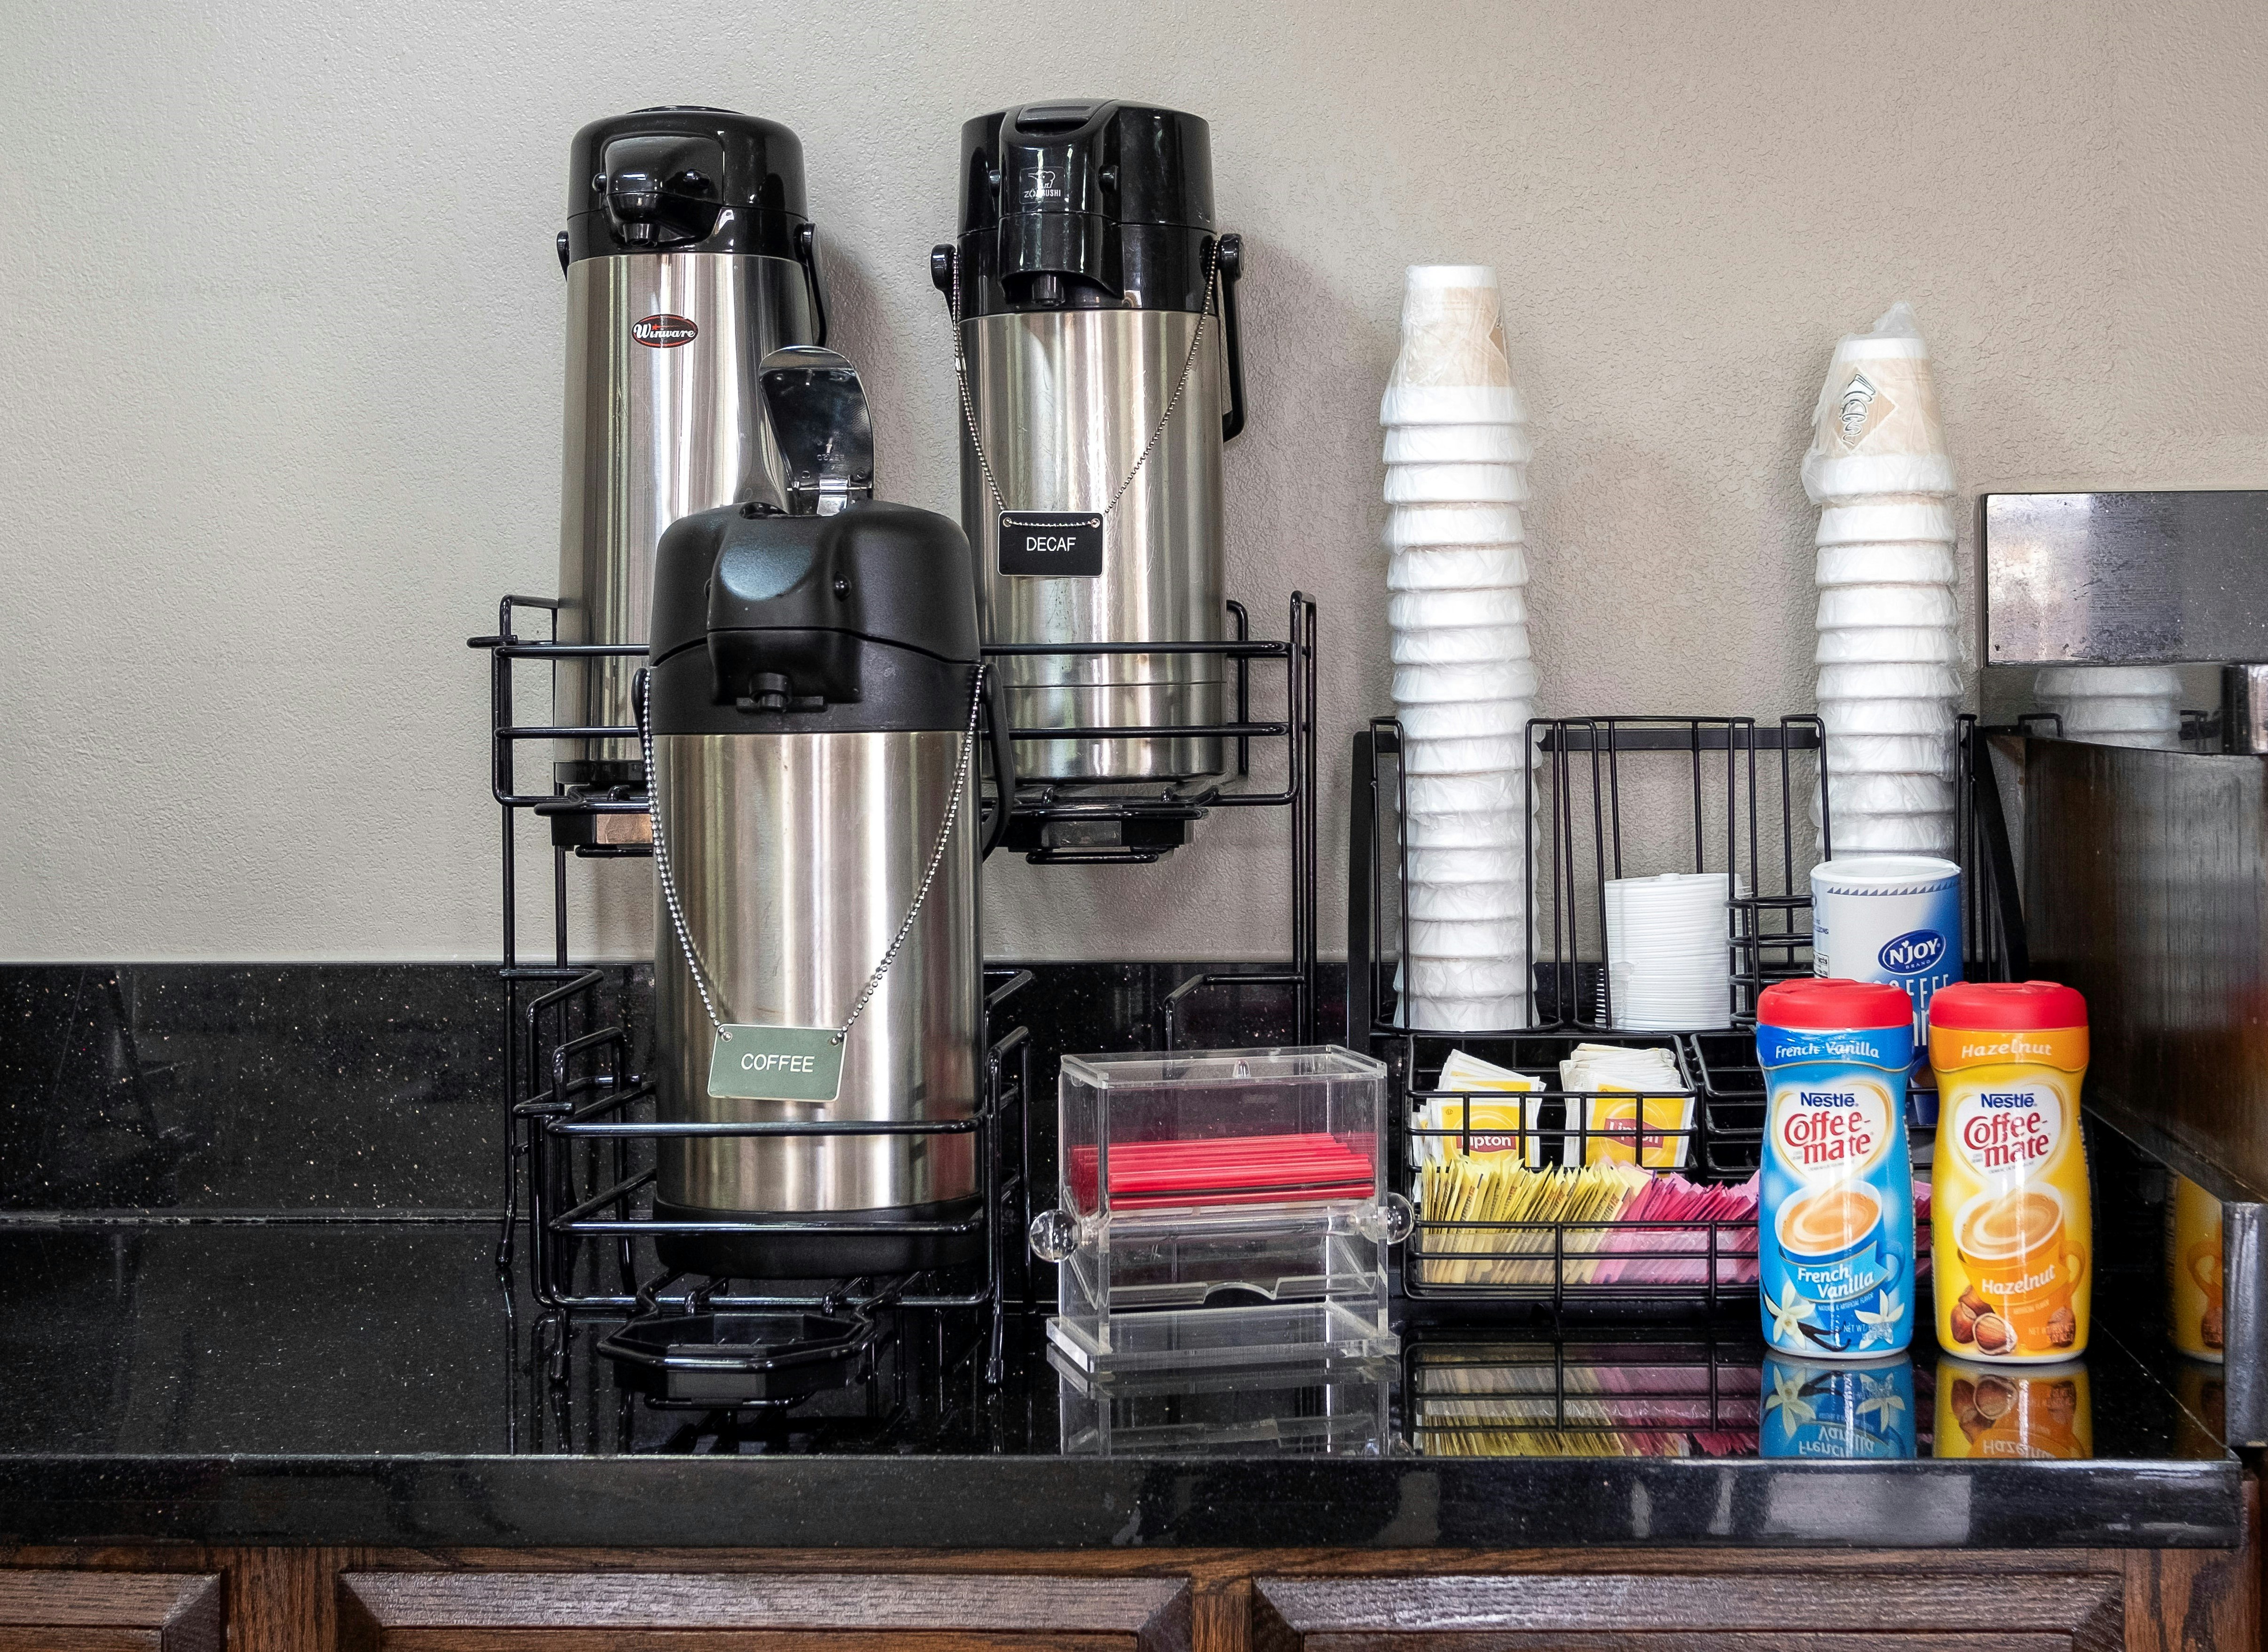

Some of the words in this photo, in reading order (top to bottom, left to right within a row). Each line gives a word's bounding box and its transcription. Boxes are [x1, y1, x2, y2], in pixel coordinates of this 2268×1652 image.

[1023, 189, 1061, 198] ZOUSHI
[633, 323, 696, 338] Winware
[1026, 537, 1076, 552] DECAF
[1905, 959, 1931, 969] BRAND
[1775, 1043, 1821, 1059] French
[1825, 1041, 1880, 1058] Vanilla
[1961, 1038, 2052, 1059] Hazelnut
[741, 1053, 816, 1073] COFFEE
[1461, 1136, 1512, 1149] ipton
[1609, 1121, 1659, 1144] Lin
[1803, 1133, 1871, 1164] mate
[1984, 1134, 2049, 1168] mate
[1797, 1263, 1849, 1283] French
[1981, 1264, 2056, 1295] Hazelnut
[1817, 1271, 1875, 1299] Vanilla
